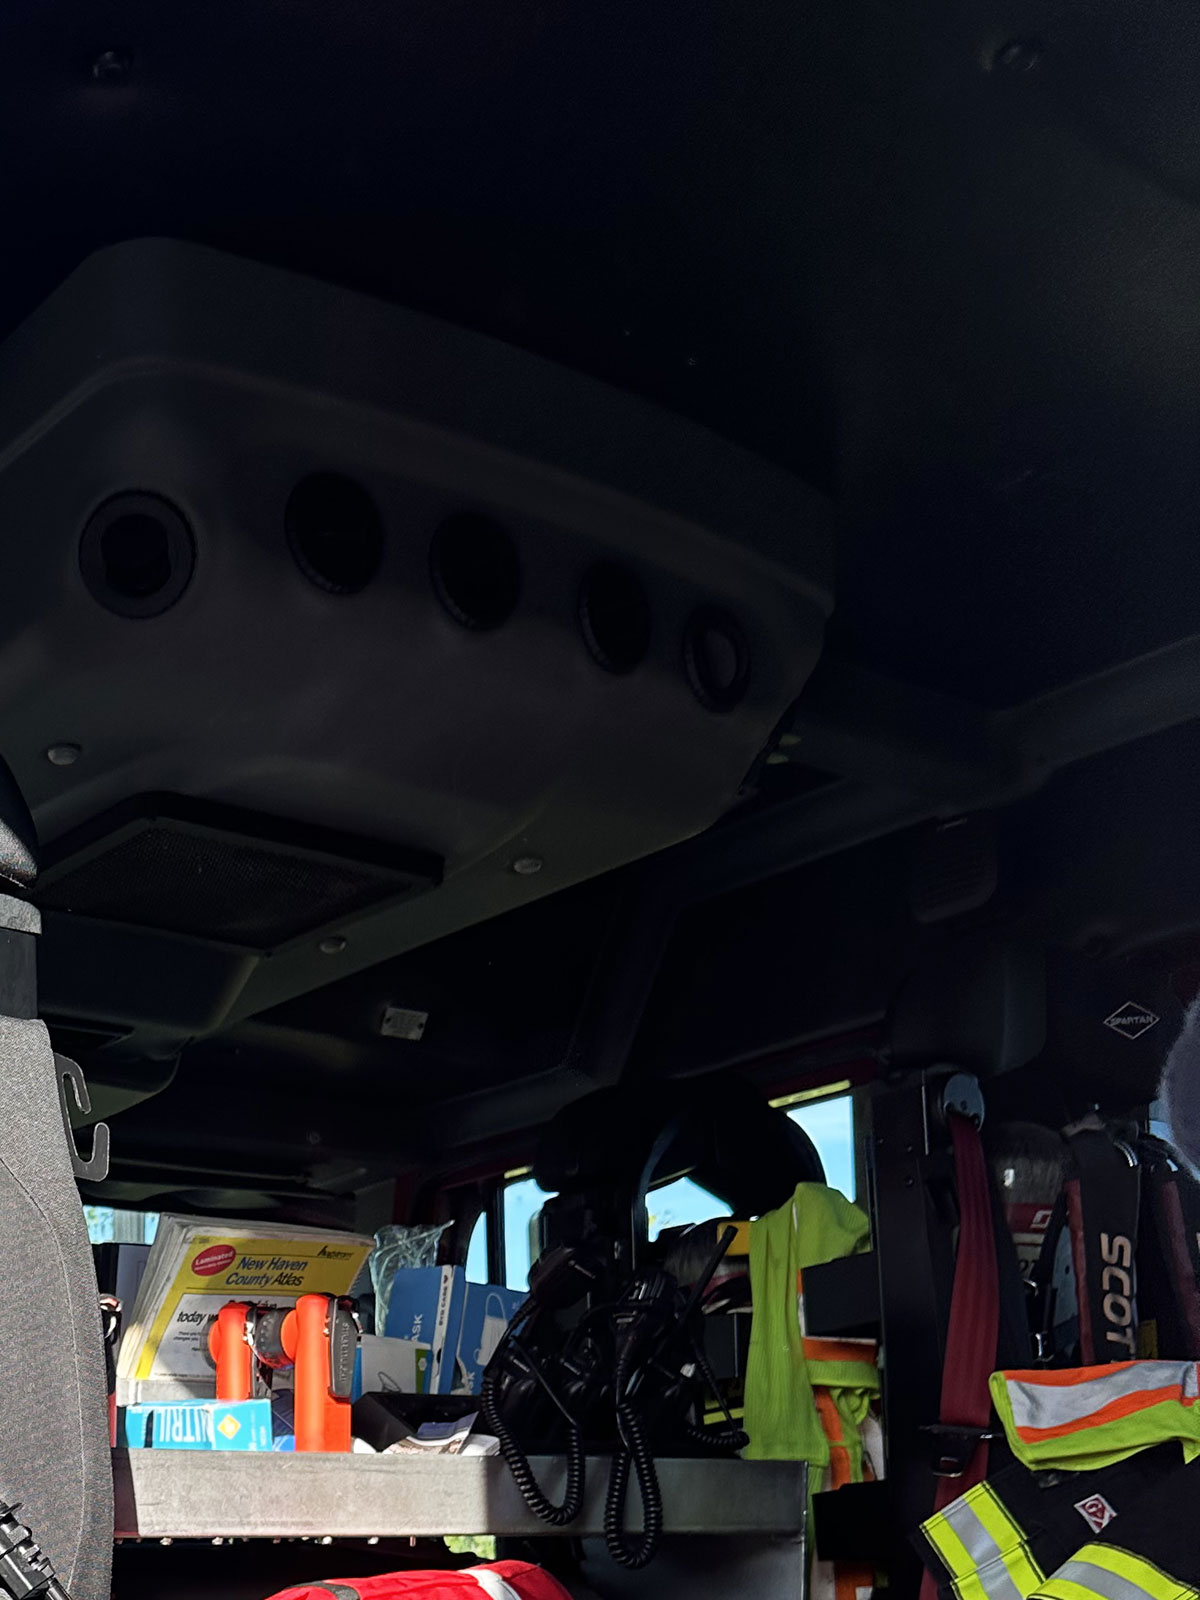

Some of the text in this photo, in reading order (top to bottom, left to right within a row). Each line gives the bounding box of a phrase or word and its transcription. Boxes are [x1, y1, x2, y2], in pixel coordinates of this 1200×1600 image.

[1110, 1015, 1153, 1026] SPARTAN
[236, 1257, 266, 1270] New
[266, 1257, 308, 1271] Haven
[225, 1272, 305, 1288] County Atlas
[1101, 1233, 1136, 1362] SCOT
[176, 1311, 206, 1326] today
[411, 1313, 423, 1341] ASK
